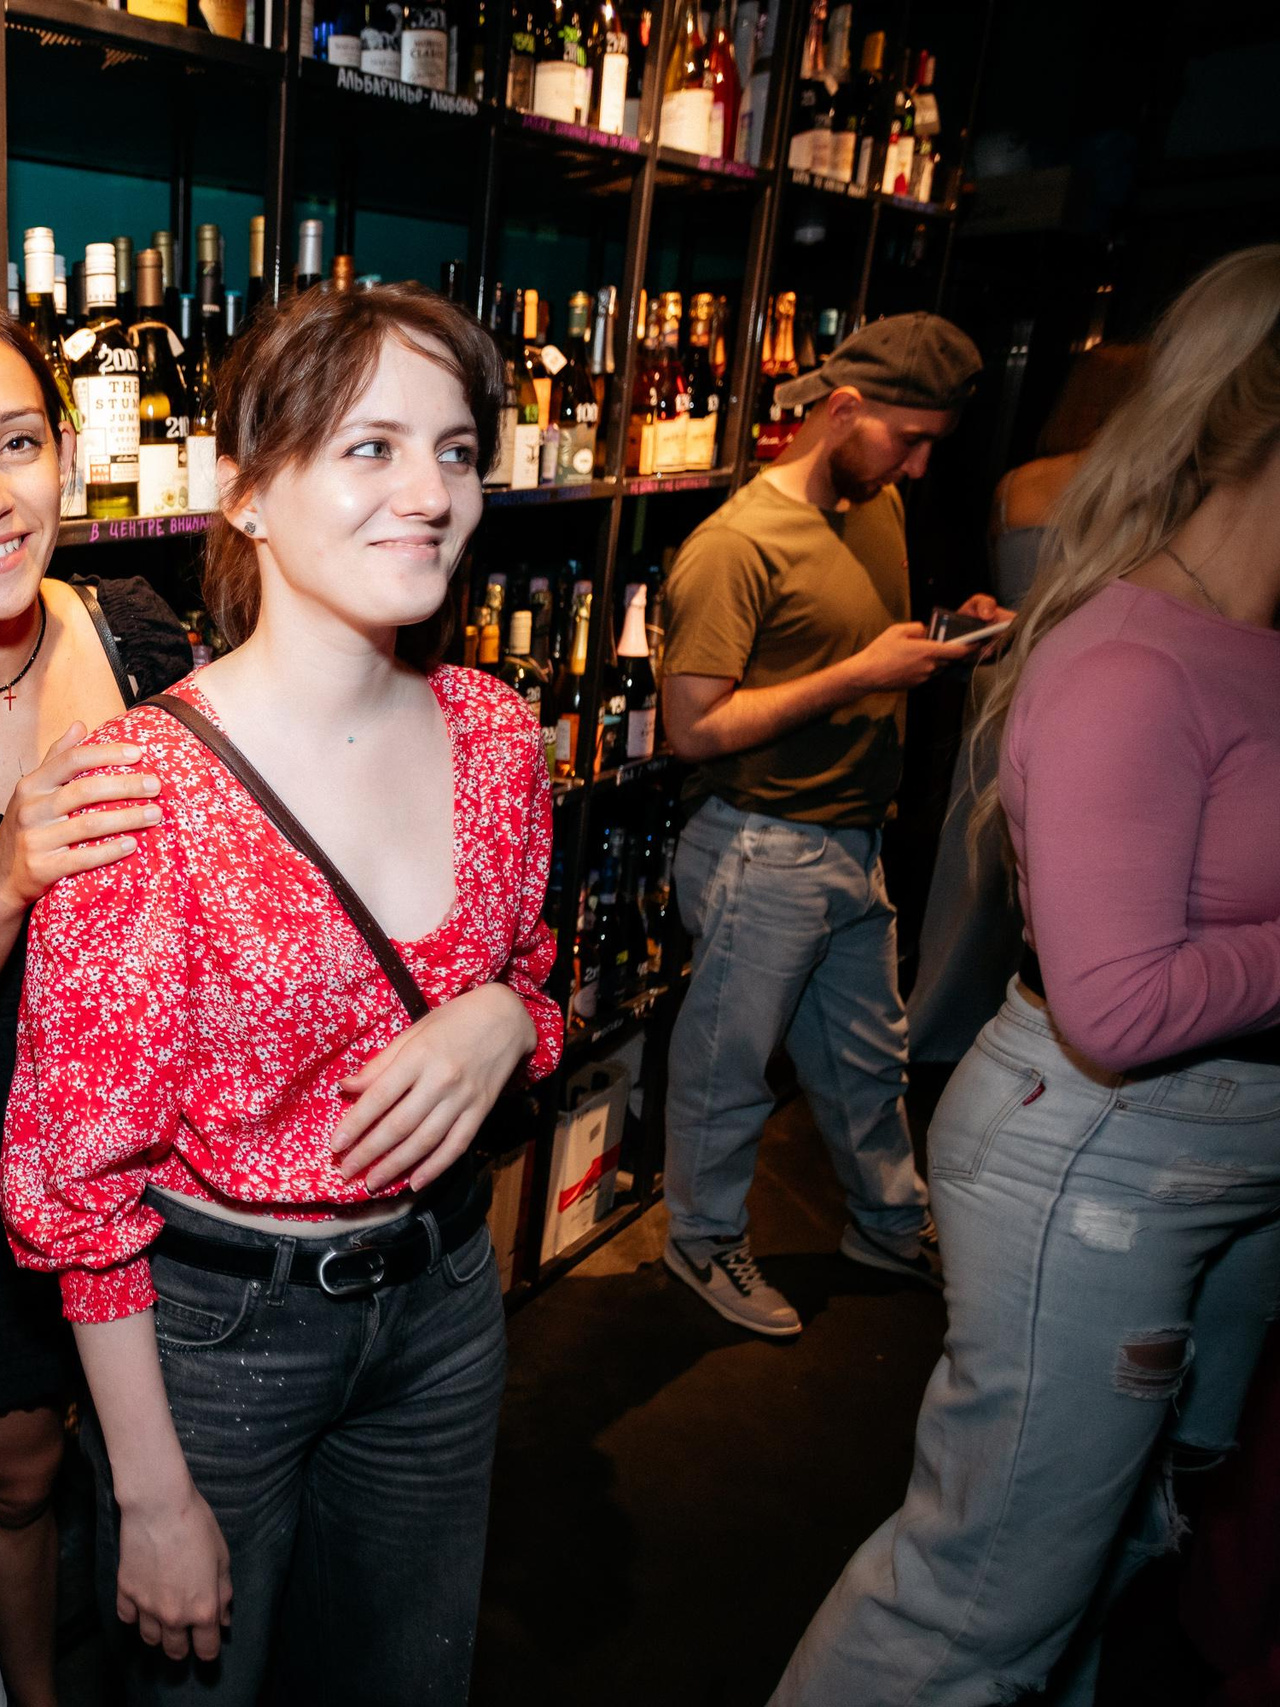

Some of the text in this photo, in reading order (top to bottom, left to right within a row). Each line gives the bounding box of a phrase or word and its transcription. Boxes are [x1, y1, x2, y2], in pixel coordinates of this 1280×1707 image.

[109, 381, 139, 393] THE
[89, 523, 99, 542] В
[109, 518, 165, 539] ЦЕНТРЕ
